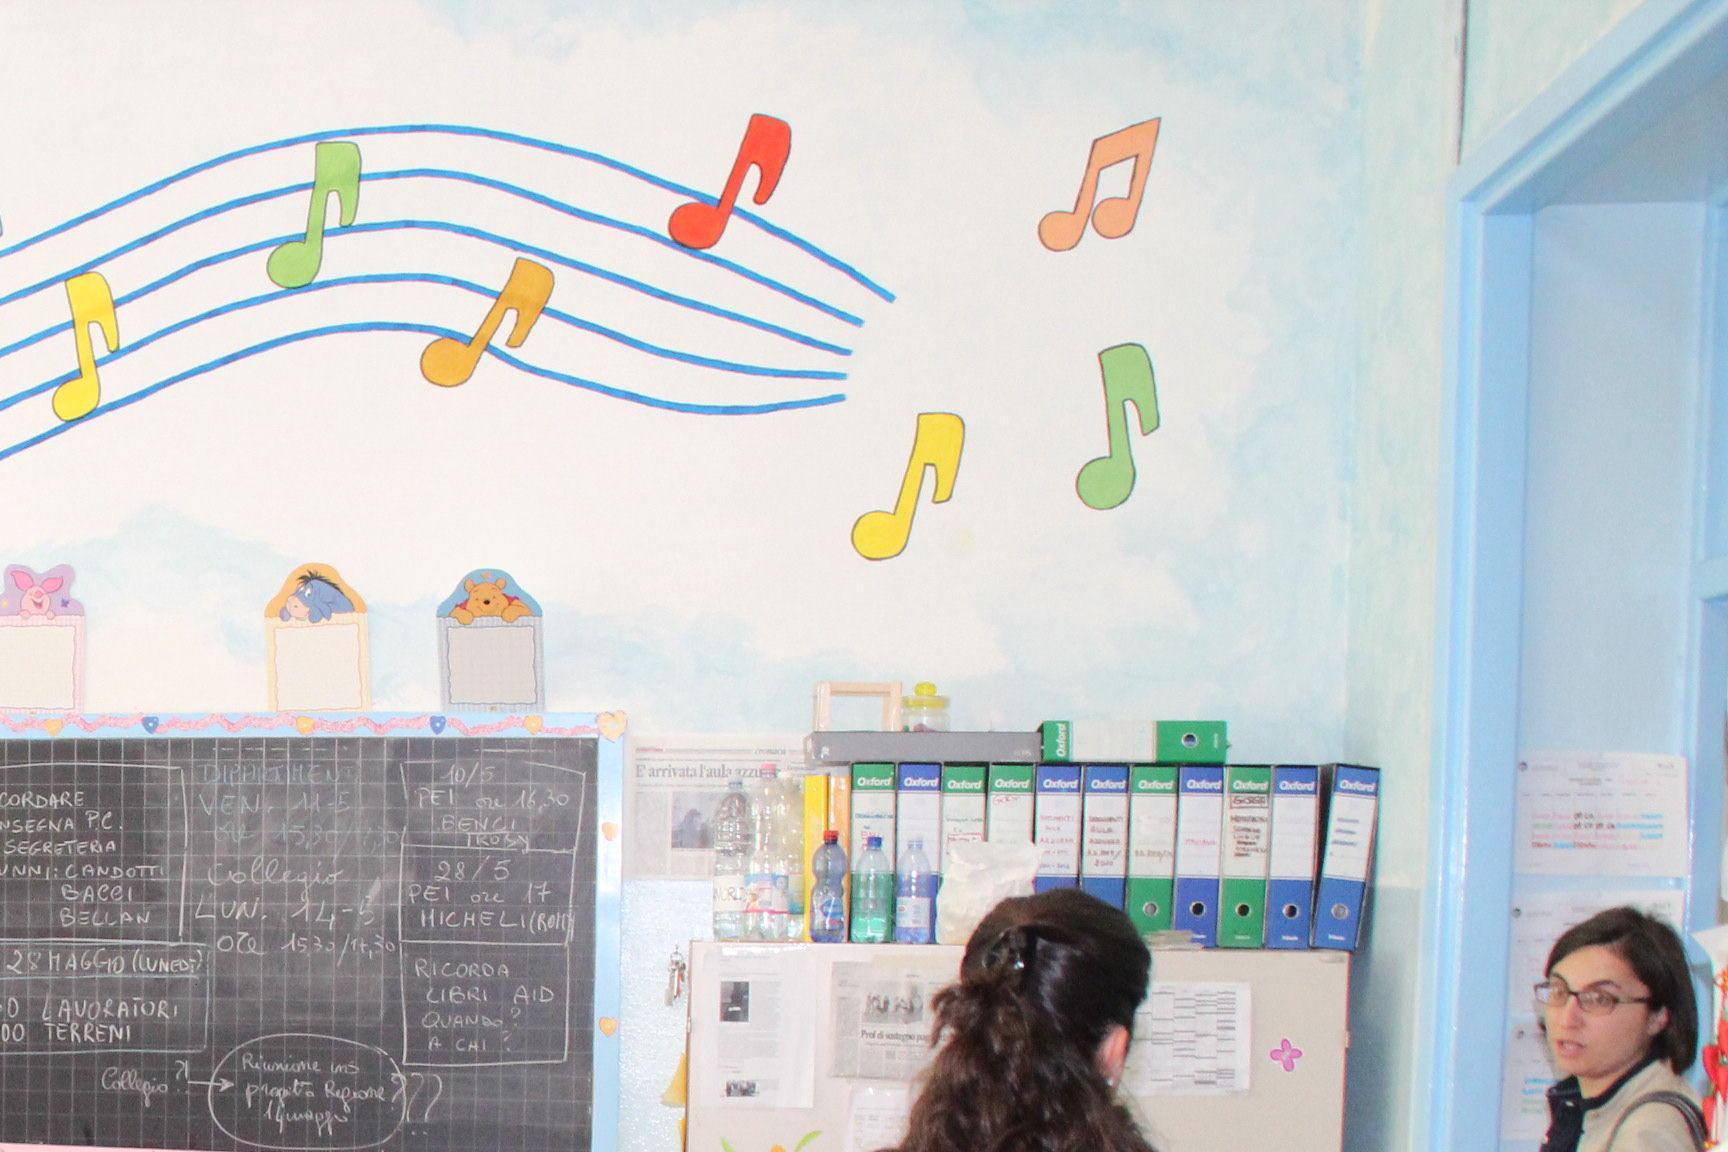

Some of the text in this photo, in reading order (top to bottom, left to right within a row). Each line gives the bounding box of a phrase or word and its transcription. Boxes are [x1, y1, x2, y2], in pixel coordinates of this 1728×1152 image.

[1056, 722, 1068, 757] Oxford
[649, 764, 697, 778] arrivata
[857, 776, 892, 787] Oxford
[904, 776, 939, 787] Oxford
[948, 779, 982, 790] Oxford
[995, 778, 1029, 789] Oxford
[1043, 779, 1078, 788] Oxford
[1091, 779, 1126, 789] Oxford
[1138, 780, 1174, 790] Oxford
[1186, 779, 1222, 790] Oxford
[1233, 780, 1268, 790] Oxford
[1279, 780, 1314, 791] Oxford
[1339, 779, 1375, 792] Oxford
[3, 840, 116, 855] SEGRETERIA
[408, 884, 450, 904] PEI
[525, 881, 552, 904] 17
[60, 907, 151, 927] BELLAN
[49, 948, 125, 975] MAGGIO
[415, 958, 510, 978] RICORDA
[426, 984, 555, 1005] LIBRI AID
[42, 992, 178, 1021] LAVORATORI
[44, 1022, 131, 1043] TERRENI
[428, 1036, 442, 1051] A
[455, 1038, 486, 1051] CHI
